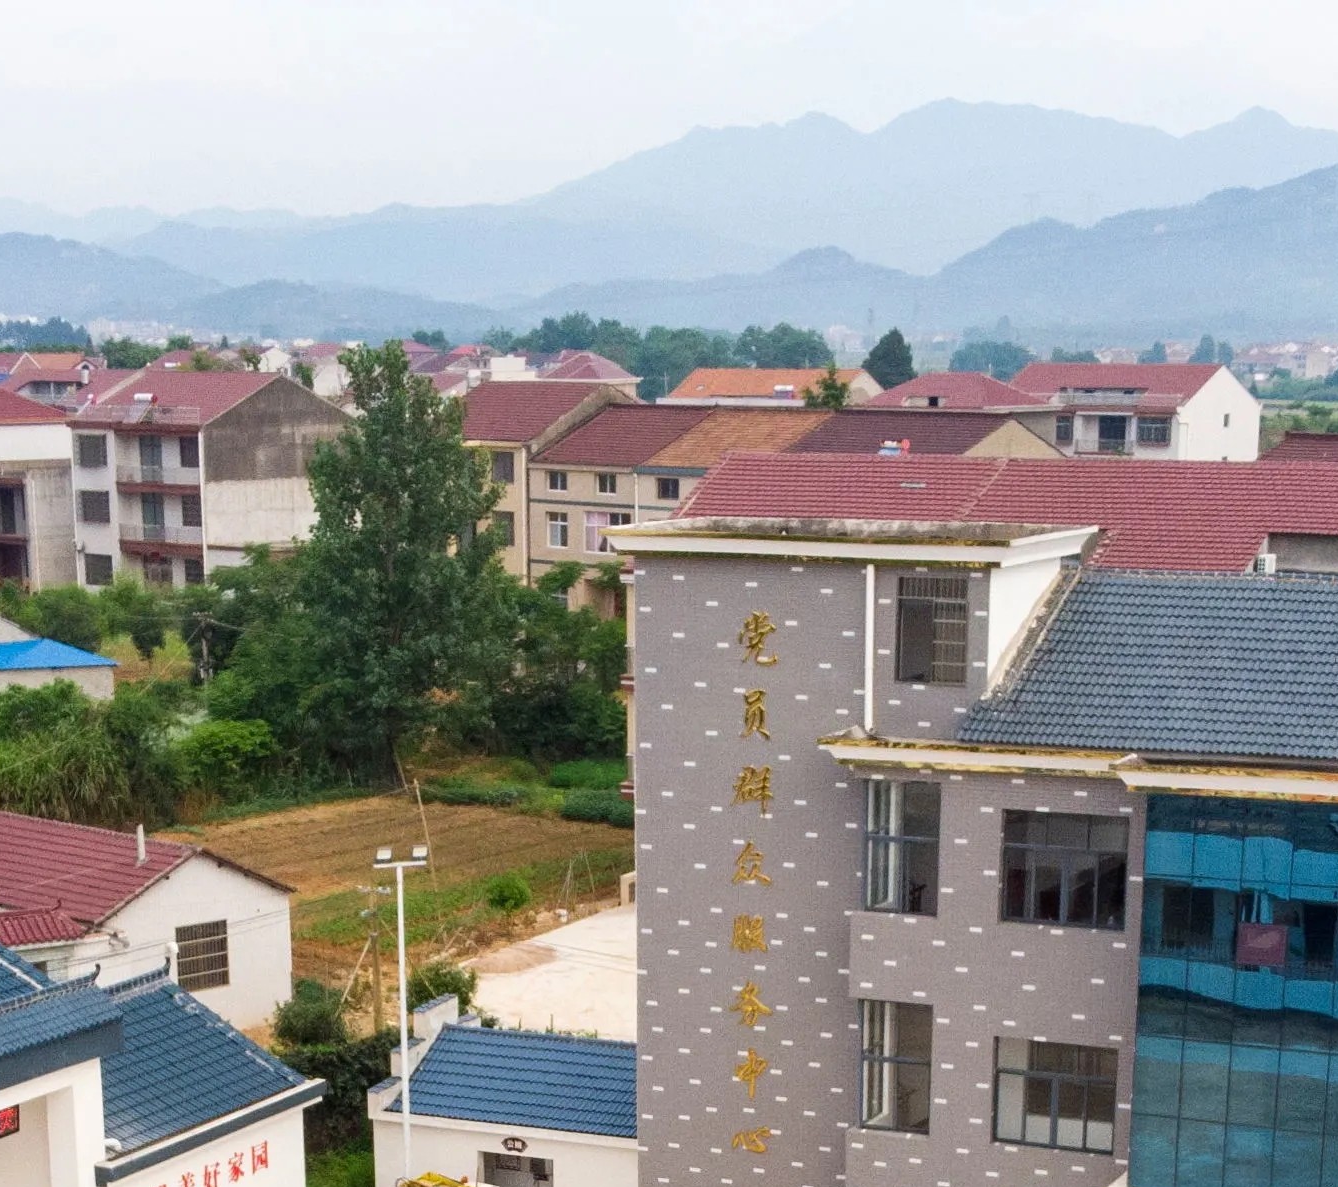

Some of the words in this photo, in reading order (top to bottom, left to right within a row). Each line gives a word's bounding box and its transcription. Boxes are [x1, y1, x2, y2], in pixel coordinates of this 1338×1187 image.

[728, 610, 779, 1155] 党员群众服务中心
